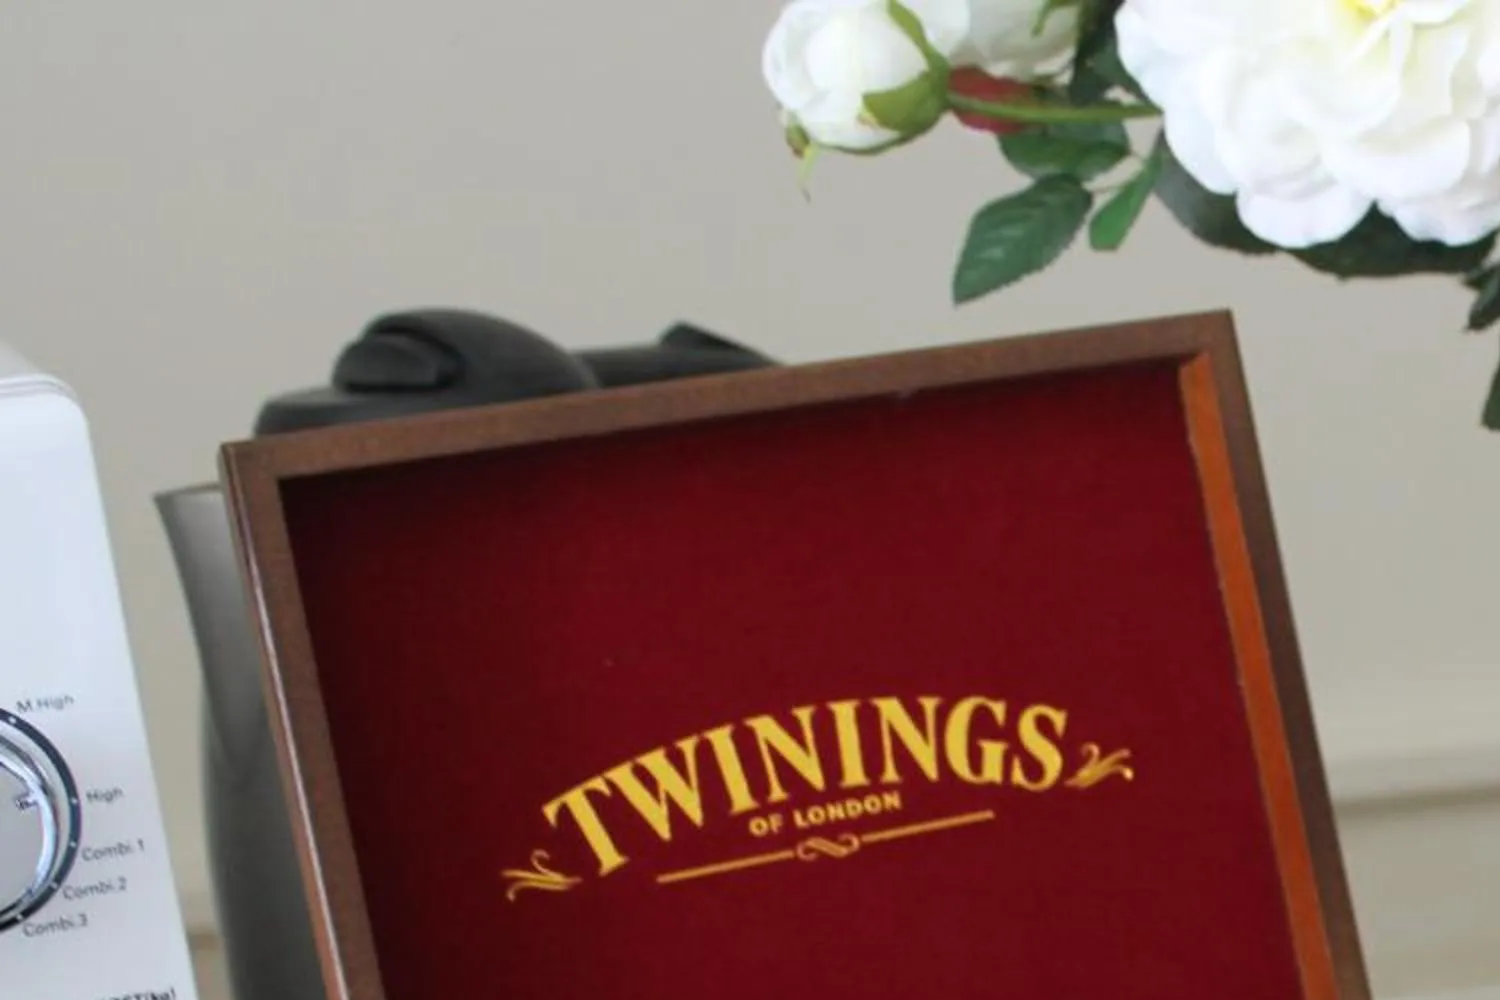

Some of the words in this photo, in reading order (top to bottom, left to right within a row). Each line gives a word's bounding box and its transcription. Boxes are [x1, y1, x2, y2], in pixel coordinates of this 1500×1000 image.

[86, 787, 124, 803] High
[542, 695, 1068, 876] TWININGS
[749, 814, 784, 837] OF
[792, 790, 903, 829] LONDON
